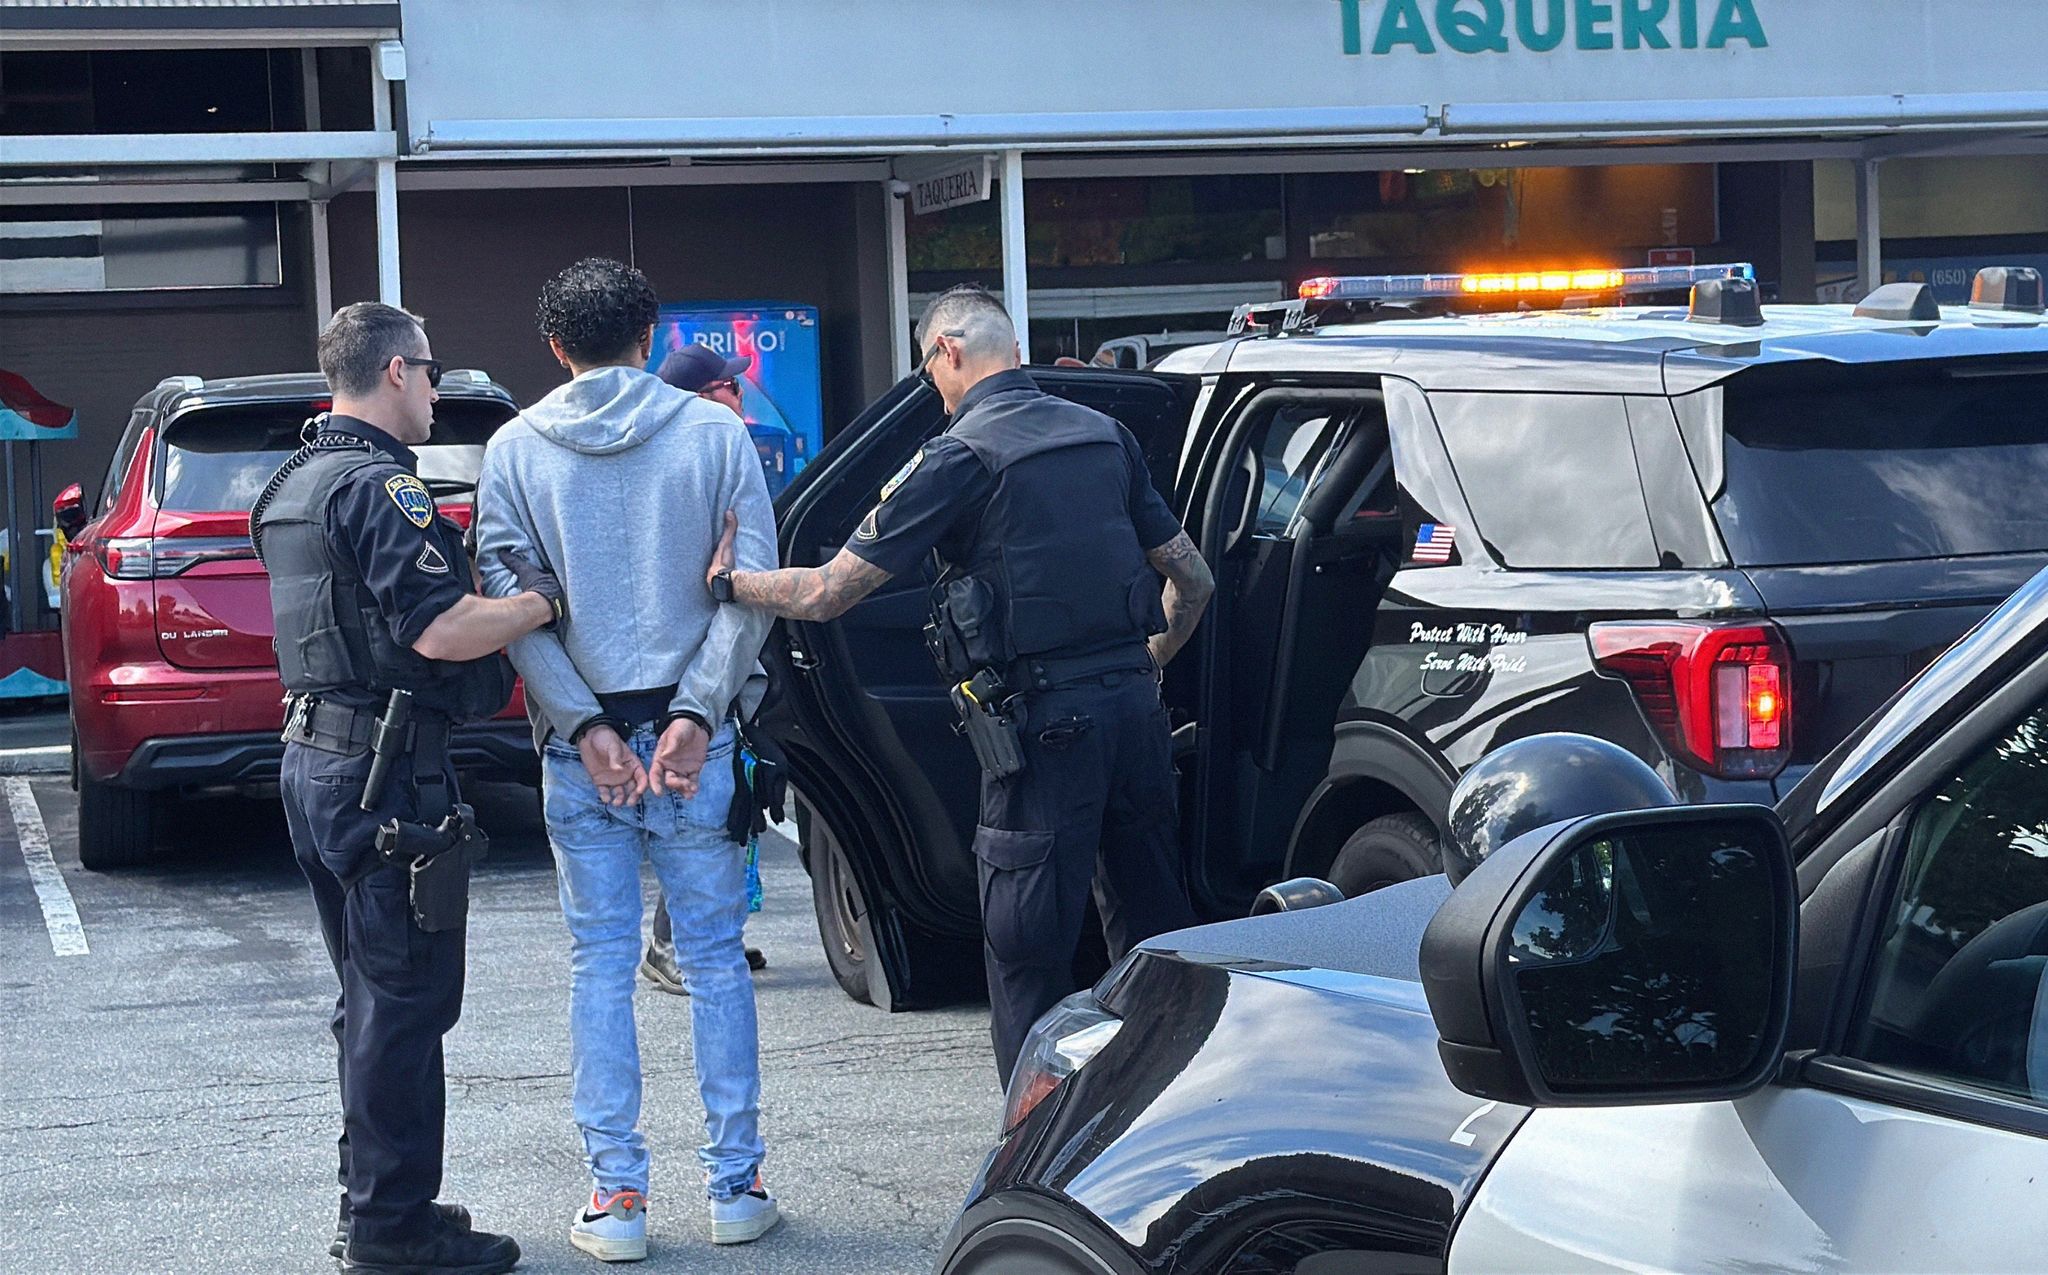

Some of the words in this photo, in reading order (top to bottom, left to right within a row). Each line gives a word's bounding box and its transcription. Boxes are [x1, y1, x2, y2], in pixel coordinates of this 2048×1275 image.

[1335, 0, 1769, 55] TAQUERIA
[917, 171, 979, 208] TAQUERIA
[1931, 269, 1967, 287] (650)
[1409, 621, 1454, 644] Protect
[1455, 622, 1488, 643] With
[1488, 623, 1528, 644] Honor
[1419, 651, 1455, 672] Serve
[1455, 652, 1489, 672] With
[1487, 653, 1527, 673] Pride
